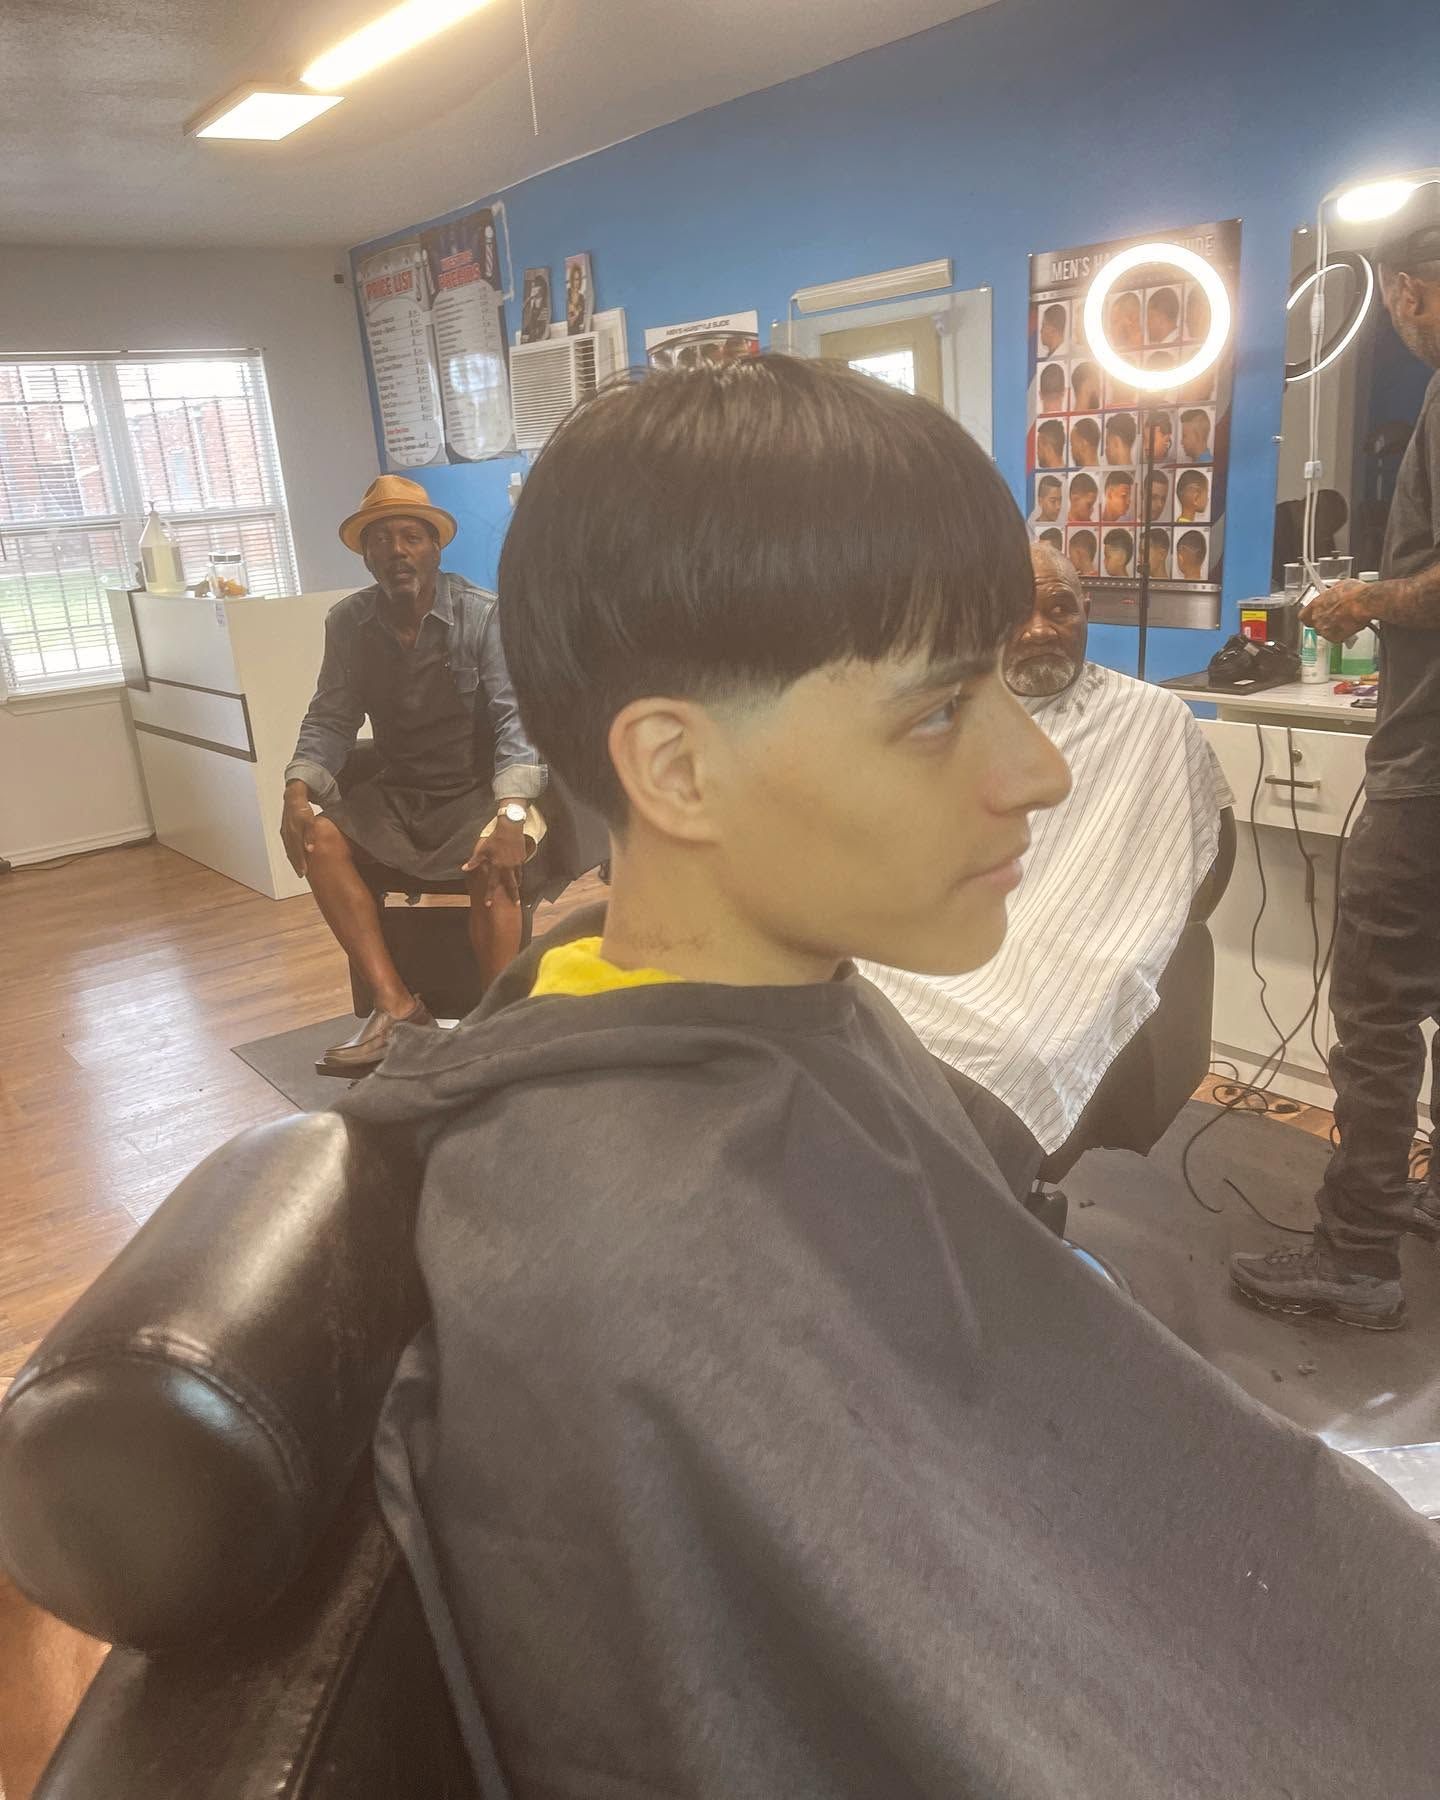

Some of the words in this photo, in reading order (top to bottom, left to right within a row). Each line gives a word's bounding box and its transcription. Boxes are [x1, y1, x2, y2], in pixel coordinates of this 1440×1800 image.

[1051, 257, 1090, 282] MEN'S
[367, 277, 393, 300] PRICE
[394, 270, 413, 292] LIST
